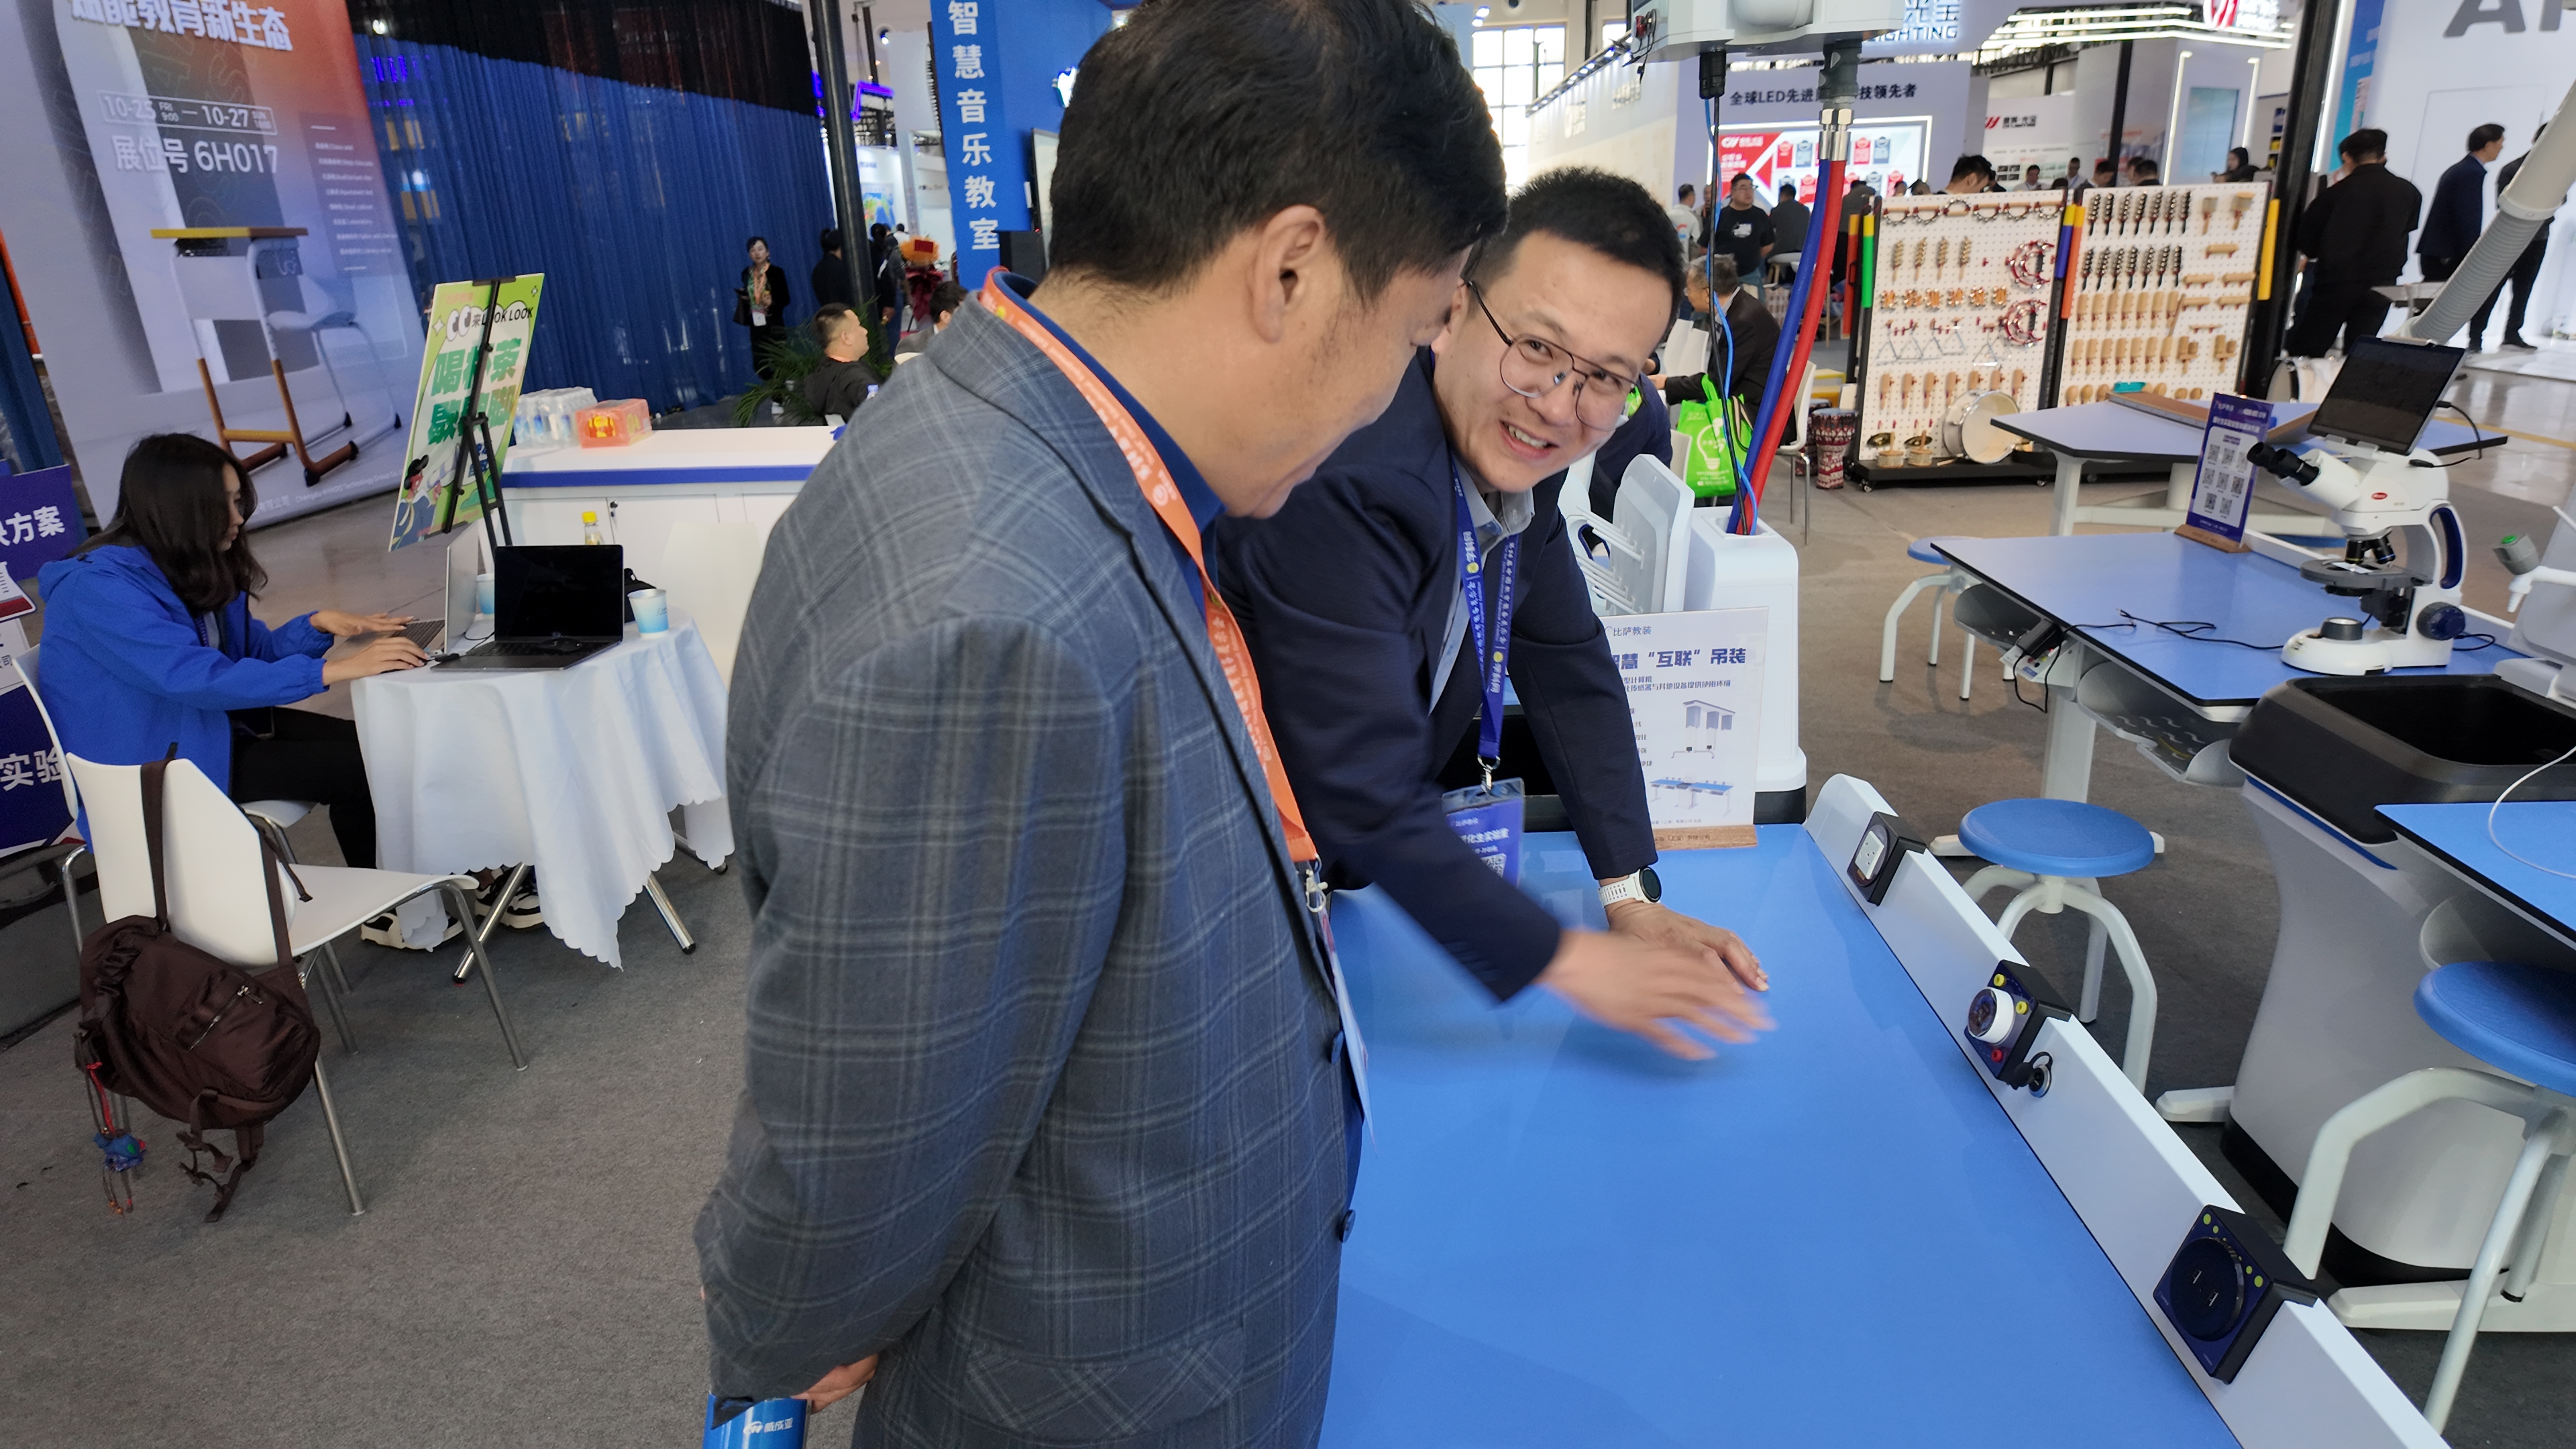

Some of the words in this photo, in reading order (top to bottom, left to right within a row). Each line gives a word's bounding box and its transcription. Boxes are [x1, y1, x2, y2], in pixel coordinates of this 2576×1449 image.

[1730, 83, 1917, 105] 全球LED先进技领先者
[103, 95, 157, 121] 10-25
[201, 105, 249, 127] 10-27
[948, 0, 1000, 250] 智慧音乐教室
[111, 135, 189, 173] 展位号
[194, 140, 277, 174] 6H017
[508, 307, 534, 321] LOOK
[1613, 626, 1652, 637] 比萨教装
[1623, 676, 1652, 684] 型计算机
